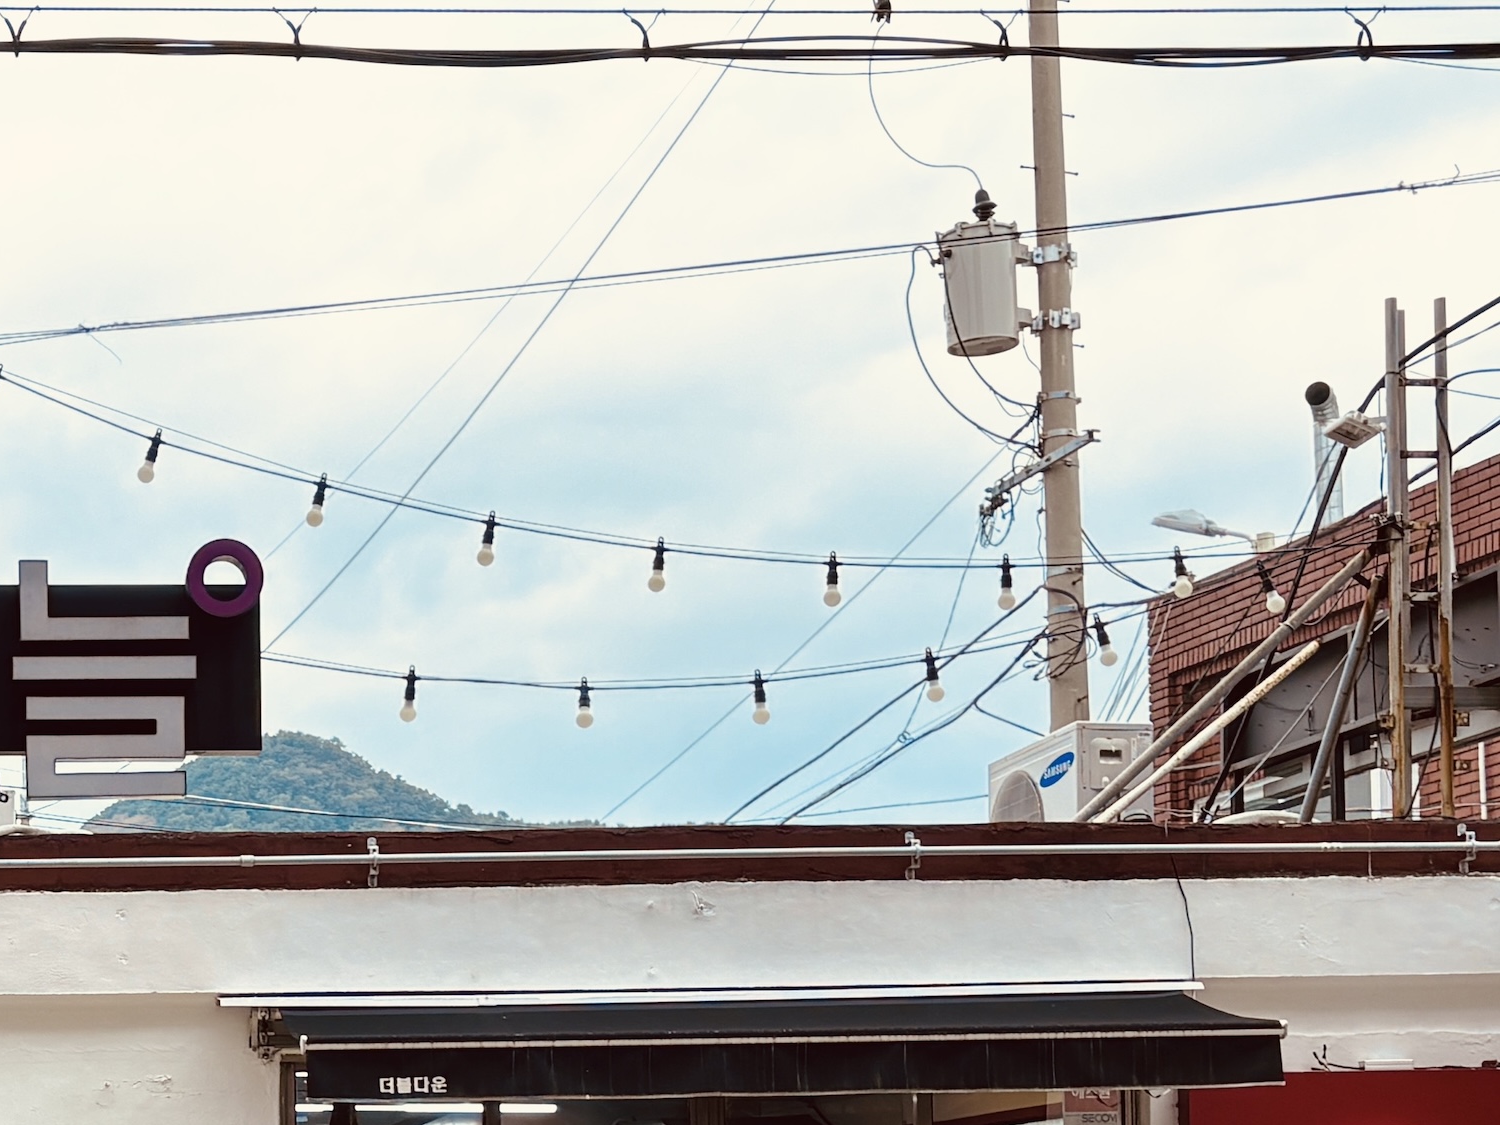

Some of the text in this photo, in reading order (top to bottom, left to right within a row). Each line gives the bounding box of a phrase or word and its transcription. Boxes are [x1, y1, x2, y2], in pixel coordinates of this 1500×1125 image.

[1043, 758, 1073, 779] SAMSUNG
[379, 1075, 448, 1095] 더블다운
[1081, 1113, 1118, 1123] SECOM
